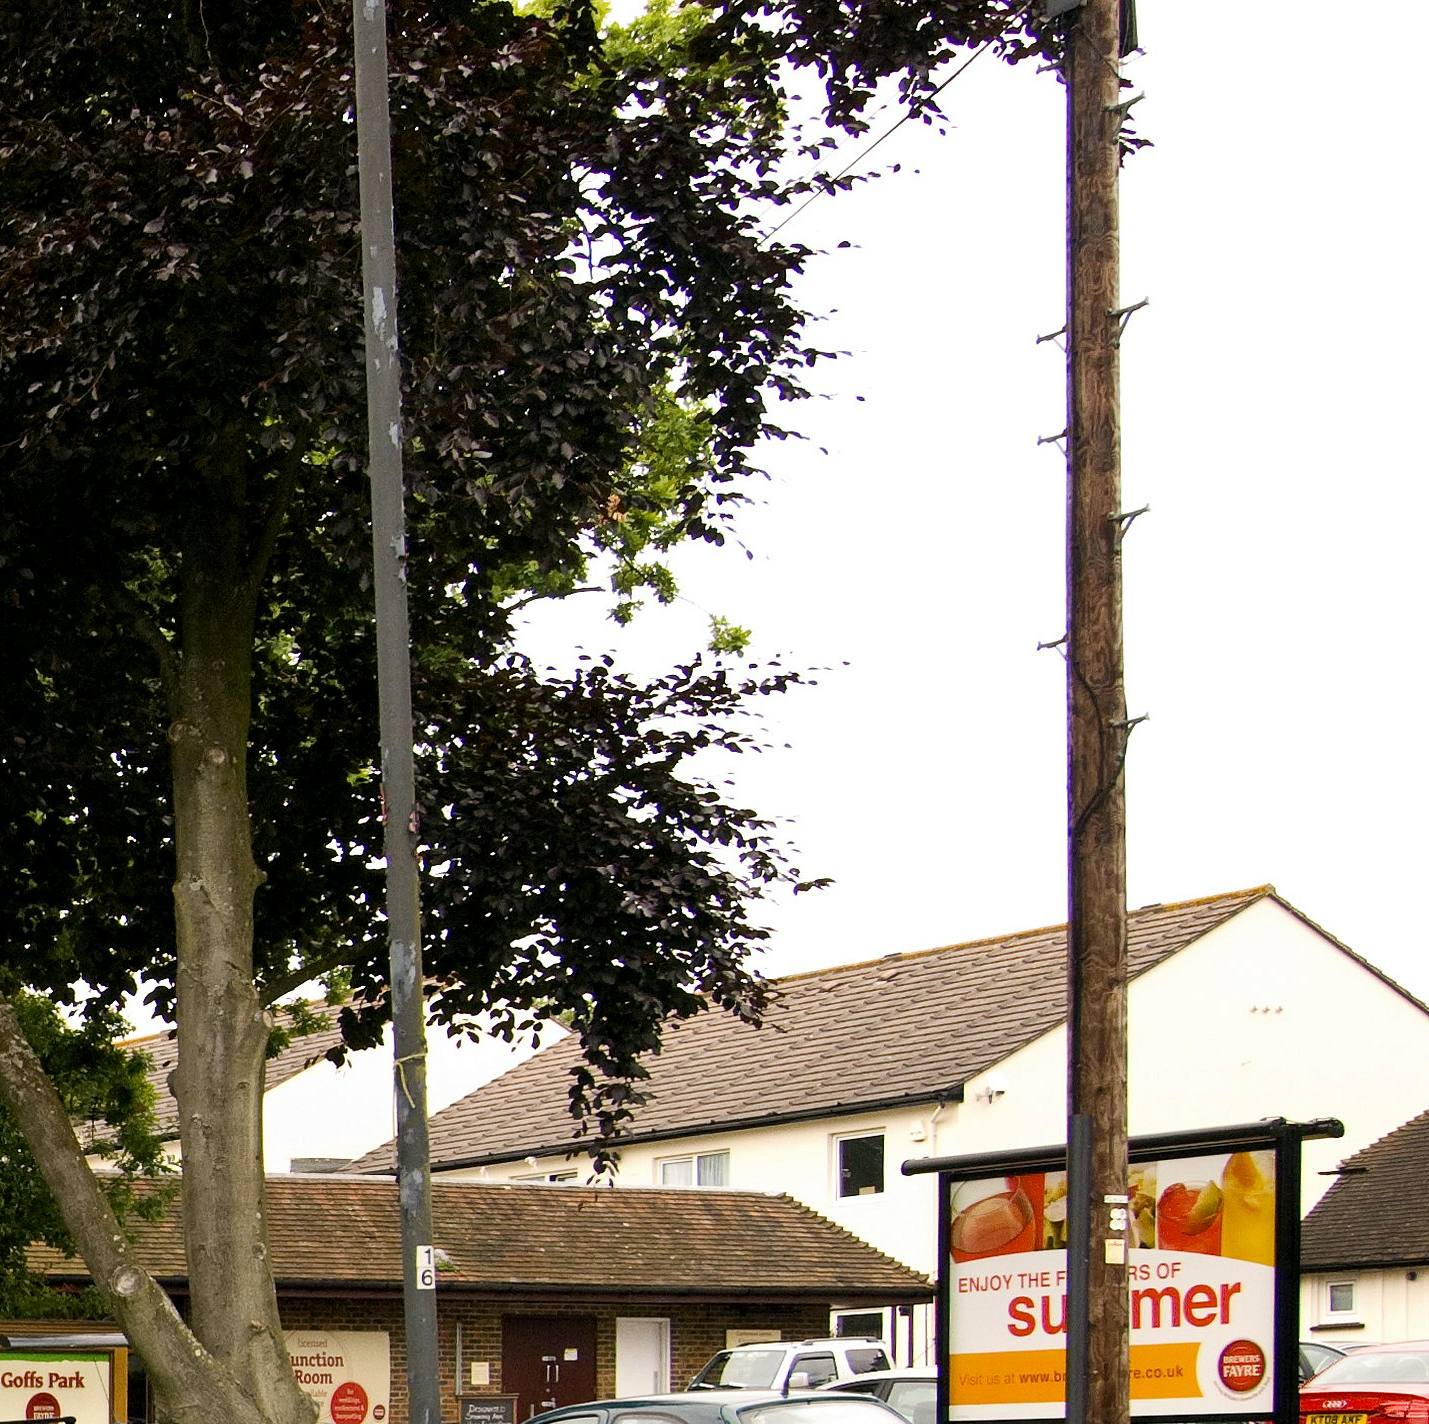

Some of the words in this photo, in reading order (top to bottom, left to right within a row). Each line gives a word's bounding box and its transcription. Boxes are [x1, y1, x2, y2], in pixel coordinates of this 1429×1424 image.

[1156, 1262, 1182, 1280] OF
[958, 1274, 1013, 1293] ENJOY
[1017, 1271, 1051, 1289] THE
[1007, 1281, 1241, 1337] sumer
[290, 1351, 345, 1367] unction
[1223, 1354, 1260, 1364] BREWERS
[294, 1369, 333, 1385] Room
[1223, 1364, 1261, 1378] FAYRE
[0, 1370, 44, 1389] Goffs
[48, 1370, 85, 1389] Park
[959, 1373, 982, 1386] Visit
[986, 1375, 1000, 1385] us
[1004, 1373, 1015, 1385] at
